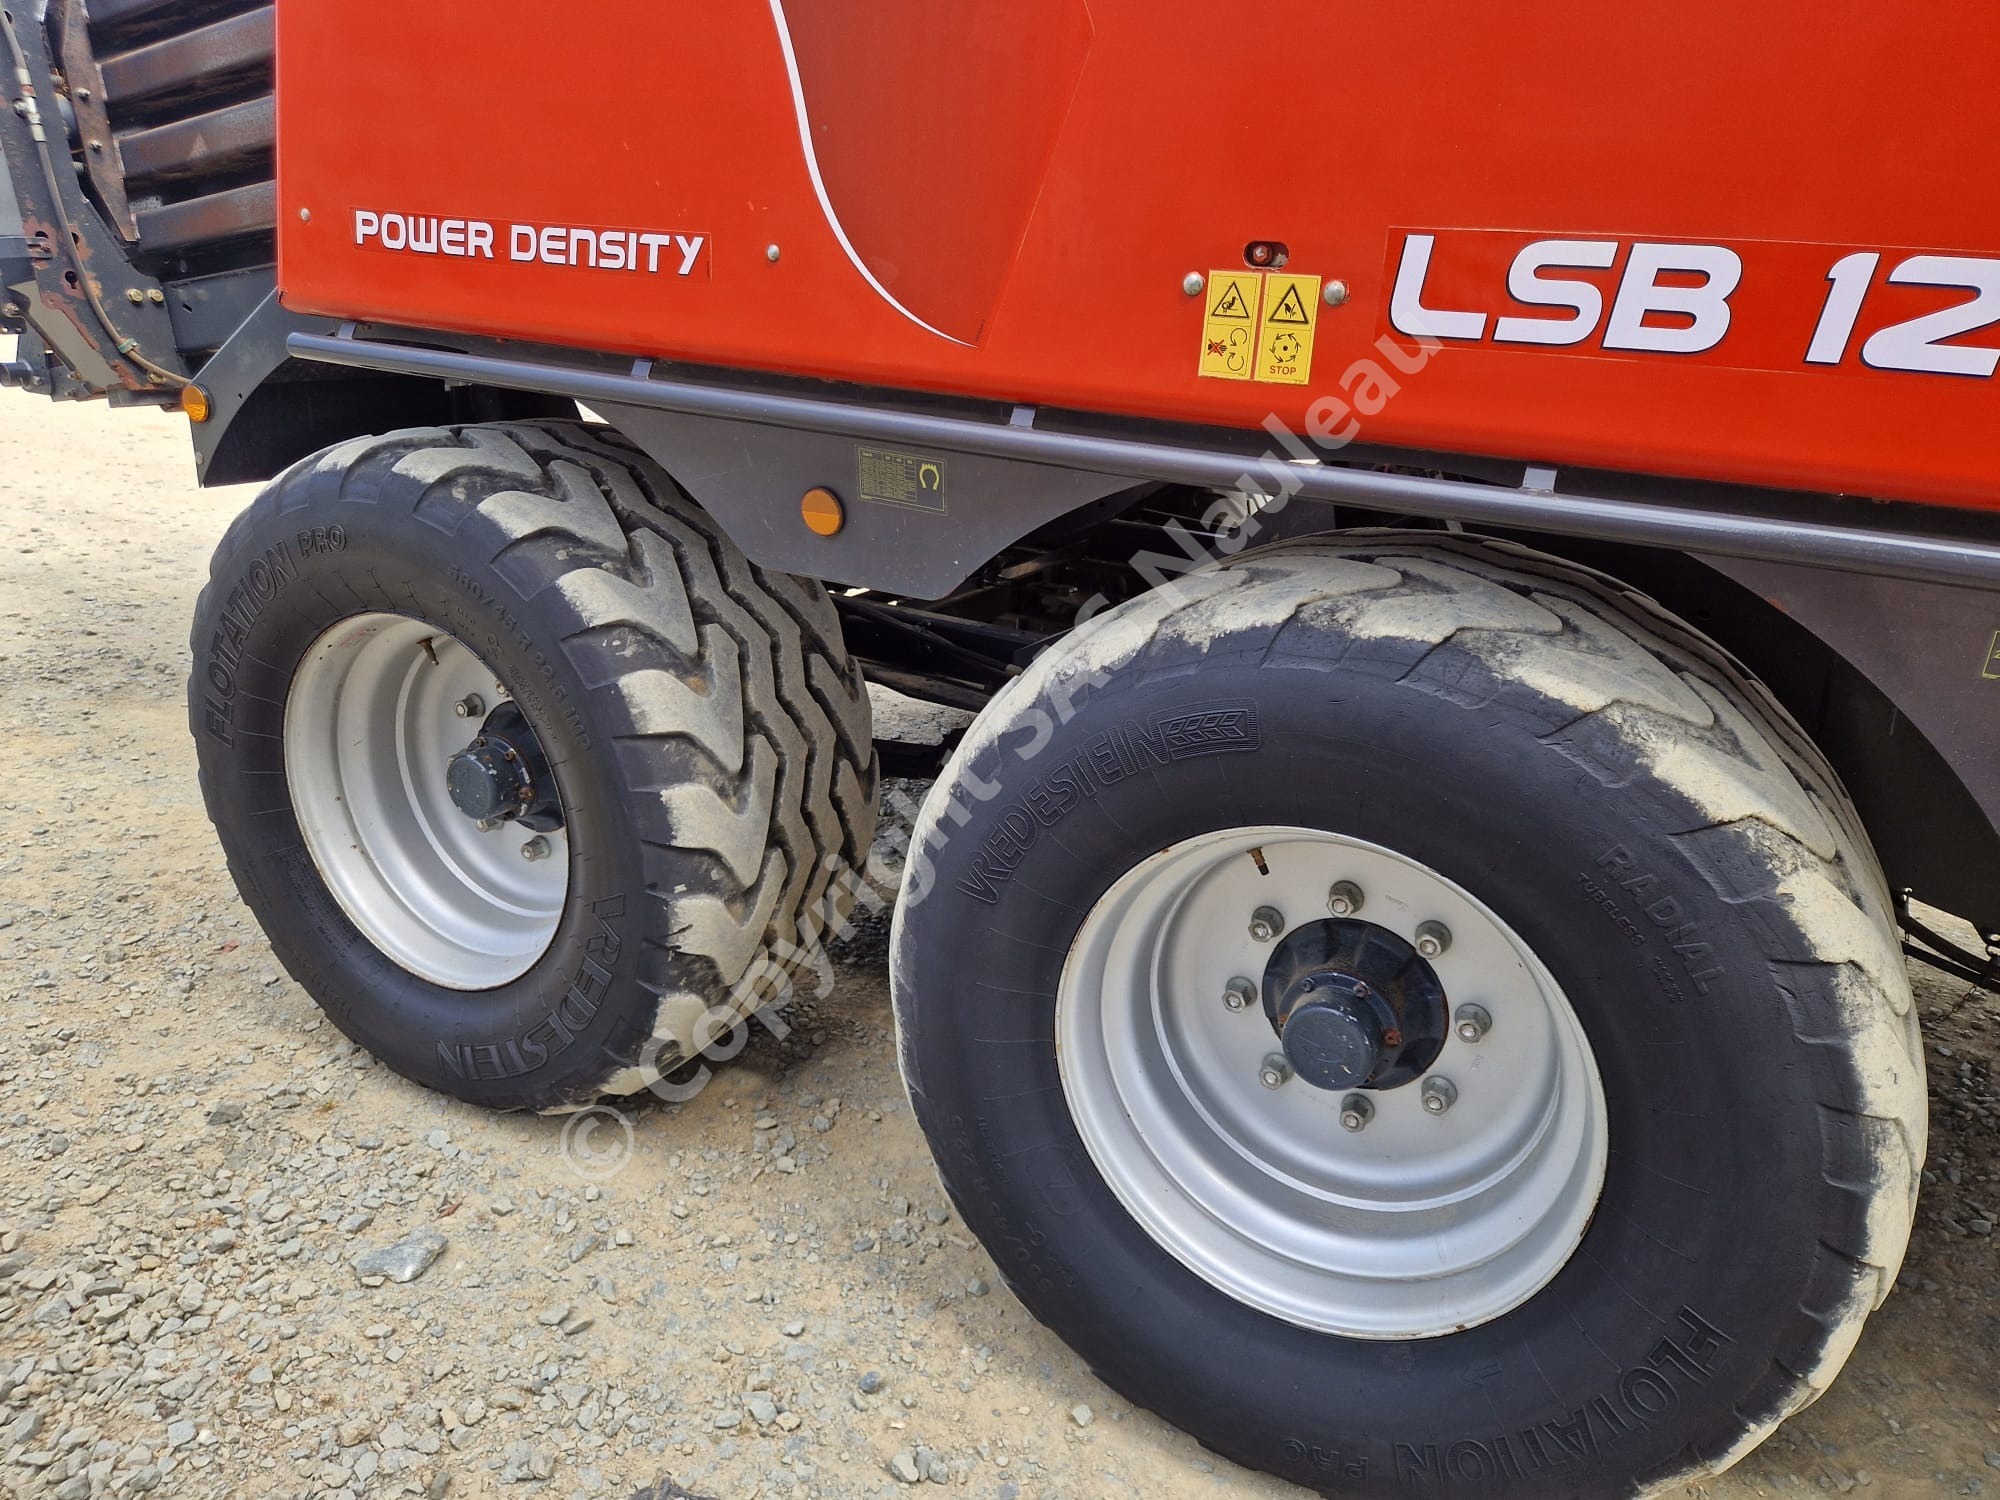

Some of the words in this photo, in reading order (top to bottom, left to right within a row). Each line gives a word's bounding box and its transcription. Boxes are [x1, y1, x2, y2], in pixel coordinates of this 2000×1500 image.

[355, 210, 494, 259] POWER
[510, 224, 704, 276] DENSITY
[1389, 234, 1743, 355] LSB
[1802, 251, 2000, 377] 12
[1269, 365, 1297, 376] STOP
[207, 541, 298, 749] FLOTATION
[297, 523, 347, 559] PRO
[954, 718, 1172, 904] VREDESTEIN
[1576, 871, 1647, 946] TUBELESS
[1596, 843, 1727, 996] RADIAL
[435, 892, 625, 1081] VREDESTEIN
[1393, 1303, 1738, 1486] FLOTATION
